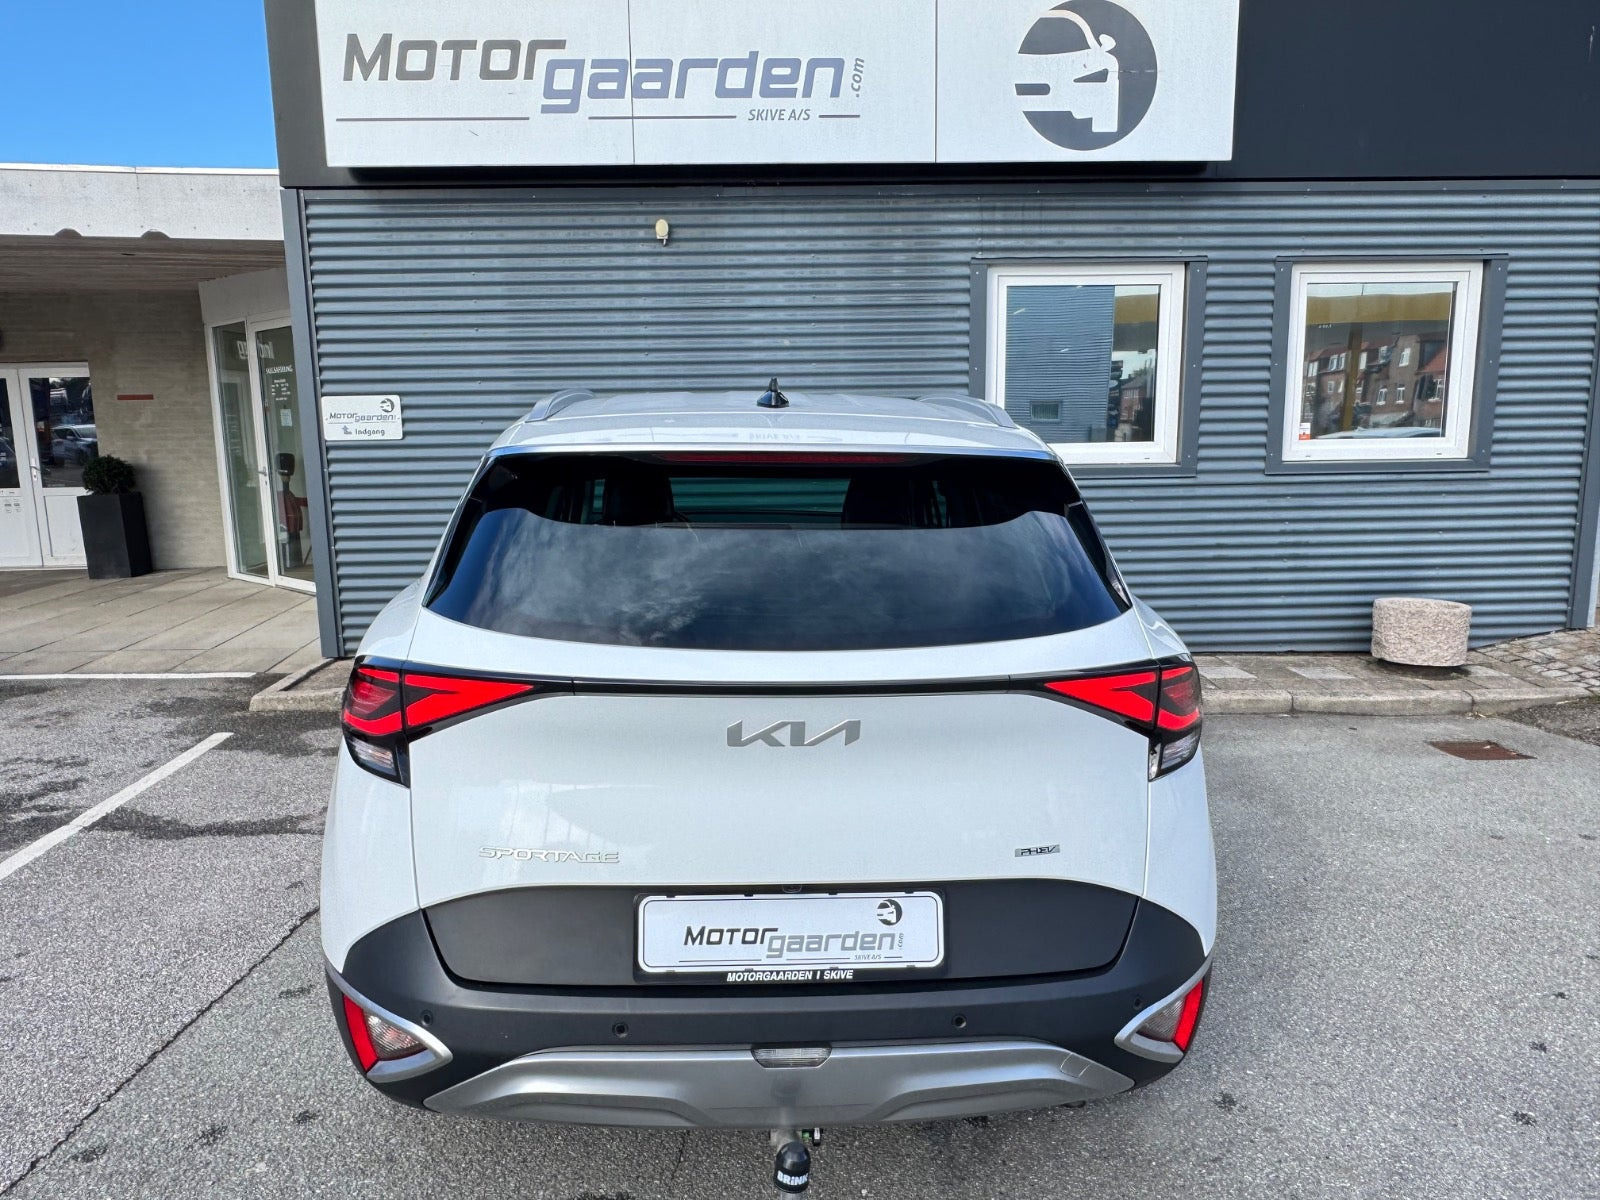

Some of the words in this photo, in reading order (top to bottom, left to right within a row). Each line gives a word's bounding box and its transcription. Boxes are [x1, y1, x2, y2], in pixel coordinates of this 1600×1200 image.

[748, 108, 786, 121] SKIVE
[787, 108, 812, 121] A/S
[355, 429, 386, 437] Indgang
[727, 719, 861, 747] KIA
[479, 847, 620, 864] SPORTAGE
[1020, 845, 1057, 856] PHEV
[726, 971, 813, 982] MOTORGAARDEN
[823, 970, 854, 980] SKIVE
